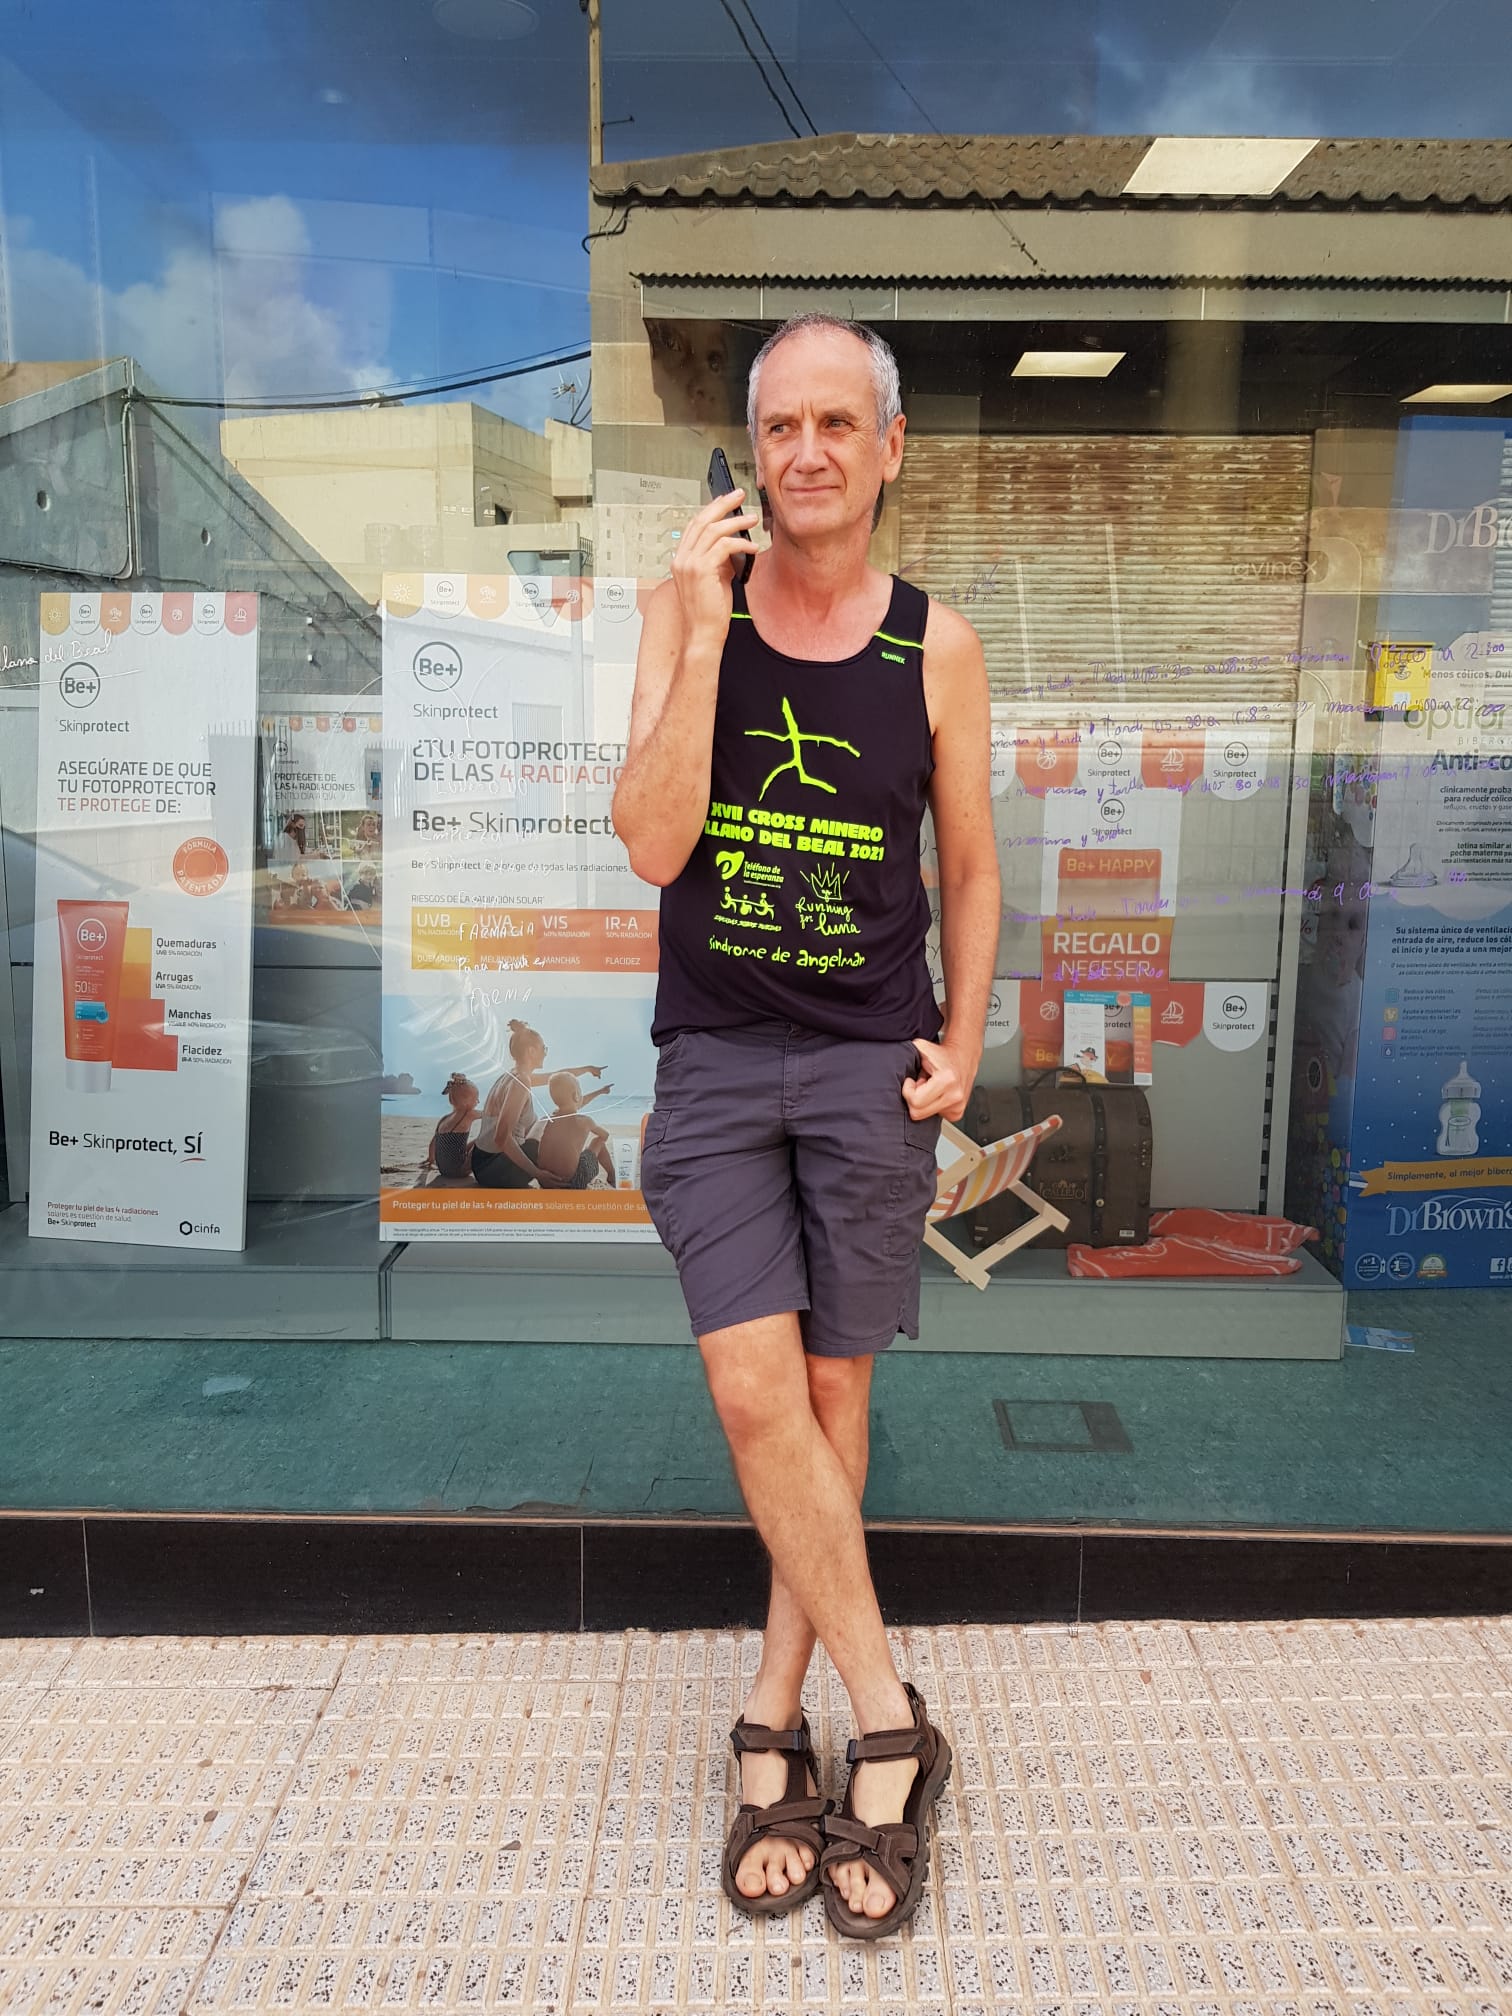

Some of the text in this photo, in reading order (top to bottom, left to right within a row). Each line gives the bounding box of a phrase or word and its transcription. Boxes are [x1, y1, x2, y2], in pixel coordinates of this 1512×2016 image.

[419, 657, 458, 676] Be+
[64, 677, 97, 695] Be+
[412, 702, 499, 721] Skinprotect
[58, 718, 130, 736] Skinprotect
[1099, 749, 1121, 759] Be+
[1226, 750, 1247, 760] Be+
[57, 757, 213, 779] ASEGÚRATE DE QUE
[414, 761, 445, 782] DE
[451, 763, 494, 783] LAS
[500, 764, 514, 783] 4
[1087, 768, 1131, 779] Skinprotect
[1212, 768, 1257, 780] Skinprotect
[57, 778, 217, 796] TU FOTOPROTECTOR
[57, 796, 182, 814] TE PROTEGE DE:
[1103, 806, 1123, 817] Be+
[412, 809, 462, 832] Be+
[710, 801, 884, 843] XVII CROSS MINERO
[758, 829, 792, 850] DEL
[796, 835, 846, 858] BEAL
[849, 843, 885, 863] 2021
[580, 862, 628, 873] radiaciones
[743, 860, 781, 875] Teléfono de
[1066, 857, 1156, 874] Be+ HAPPY
[750, 871, 785, 885] esperanza
[411, 894, 446, 904] RIESGOS
[416, 912, 451, 928] UVB
[542, 914, 569, 930] VIS
[605, 916, 639, 931] IR-A
[80, 929, 104, 943] Be+
[1395, 926, 1406, 935] Su
[1407, 926, 1440, 935] sistema
[1440, 925, 1463, 934] único
[1464, 925, 1474, 934] de
[156, 937, 217, 950] Quemaduras
[1053, 931, 1161, 956] REGALO
[1391, 935, 1498, 945] entrada de aire, reduce los
[1391, 946, 1400, 955] el
[1401, 945, 1423, 954] inicio
[1440, 945, 1464, 955] ayuda
[771, 945, 791, 964] de
[796, 947, 865, 975] angelman
[1061, 959, 1151, 978] NECESER
[155, 971, 194, 984] Arrugas
[168, 1008, 213, 1021] Manchas
[1225, 1002, 1246, 1013] Be+
[1212, 1021, 1255, 1032] Skinprotect
[182, 1044, 223, 1057] Flacidez
[49, 1130, 204, 1156] Be+ Skinprotect, SÍ
[1387, 1170, 1447, 1182] Simplemente,
[1459, 1168, 1485, 1179] mejor
[47, 1201, 76, 1212] Proteger
[75, 1203, 83, 1212] tu
[83, 1203, 95, 1213] piel
[95, 1205, 105, 1213] de
[105, 1205, 115, 1214] las
[121, 1207, 159, 1216] radiaciones
[392, 1200, 430, 1212] Proteger
[431, 1201, 441, 1210] tu
[442, 1200, 458, 1212] piel
[460, 1201, 471, 1210] de
[472, 1201, 485, 1210] las
[494, 1201, 543, 1211] radiaciones
[623, 1203, 634, 1211] de
[47, 1217, 97, 1228] Be+ Skinprotect
